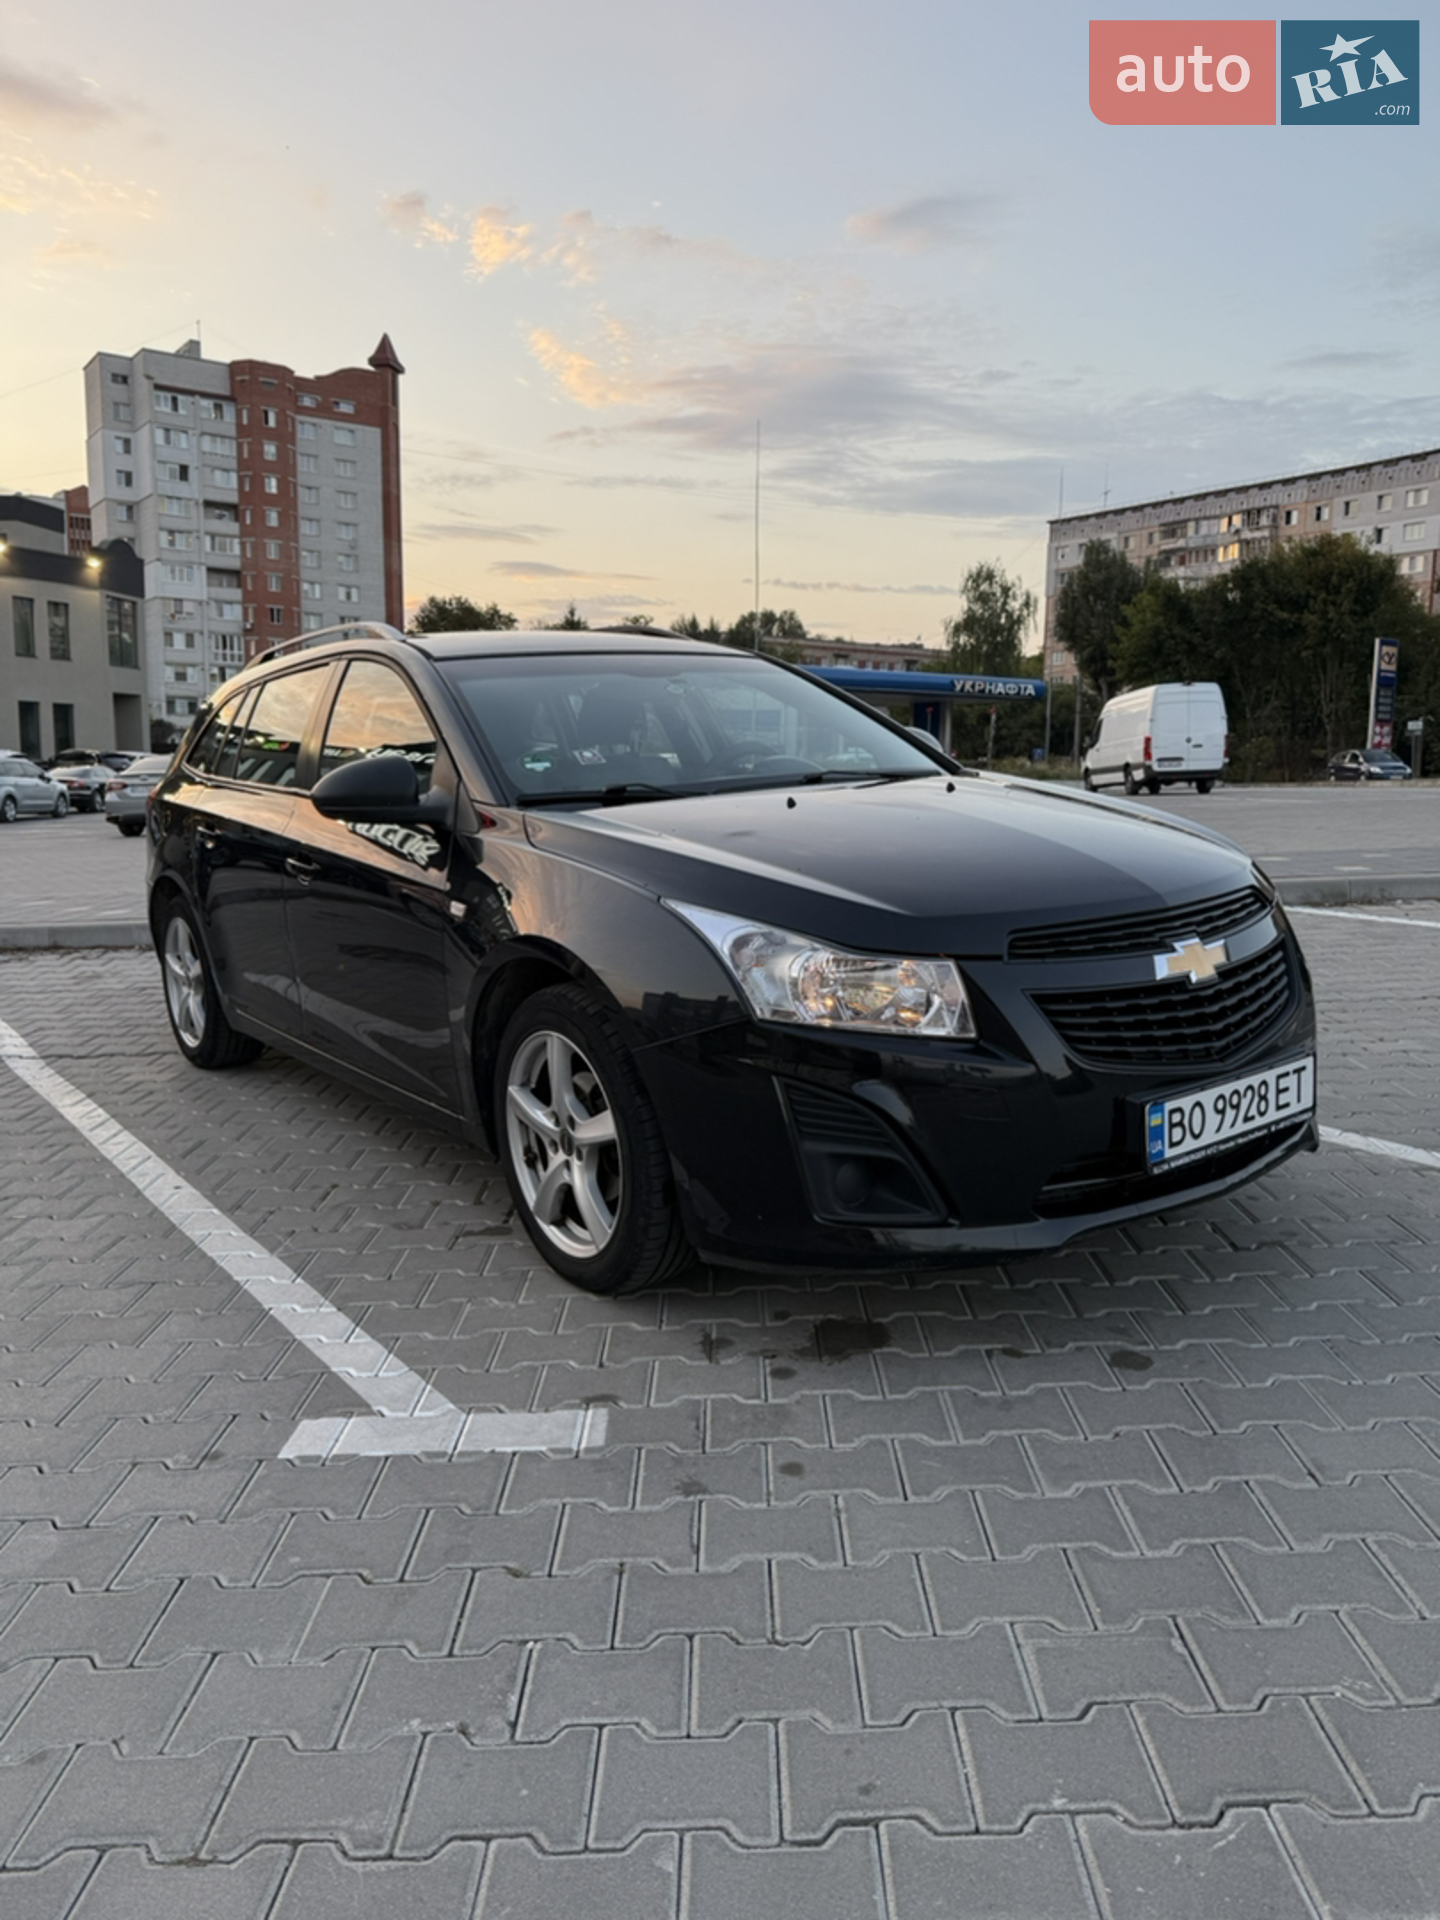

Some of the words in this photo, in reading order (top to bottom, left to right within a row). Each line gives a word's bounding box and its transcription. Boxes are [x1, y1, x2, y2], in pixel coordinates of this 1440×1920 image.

[953, 679, 1036, 696] УКРНАФТА
[1168, 1100, 1206, 1149] BO
[1213, 1079, 1270, 1135] 9928
[1275, 1064, 1307, 1112] ET
